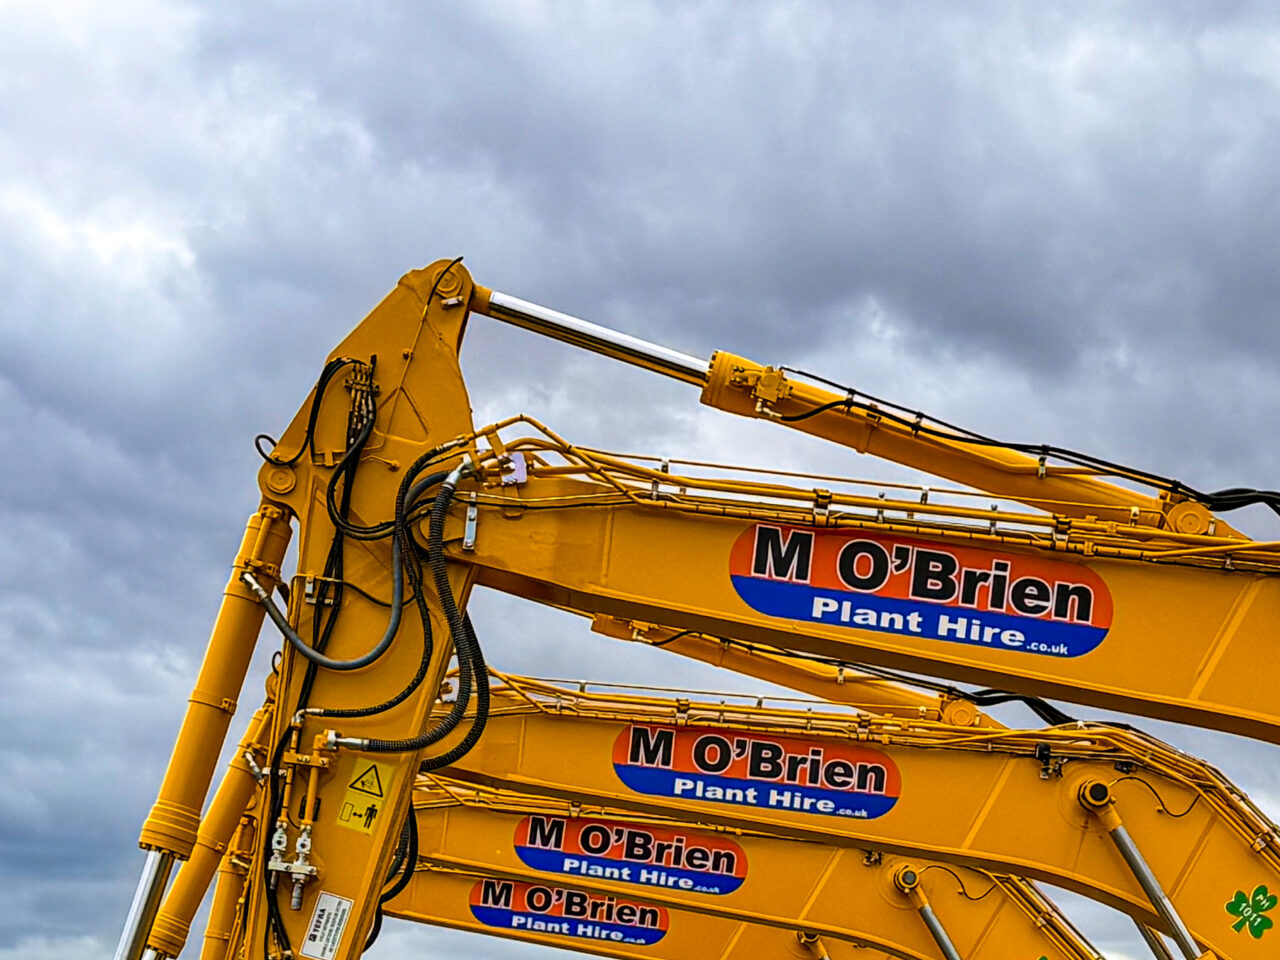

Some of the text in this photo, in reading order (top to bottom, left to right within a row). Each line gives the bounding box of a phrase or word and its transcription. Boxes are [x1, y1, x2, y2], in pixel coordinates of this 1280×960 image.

[753, 524, 1094, 624] M O'Brien
[812, 597, 923, 633] Plant
[628, 725, 887, 795] M O'Brien
[674, 778, 758, 803] Plant
[527, 815, 736, 876] M O'Brien
[563, 858, 631, 880] Plant
[480, 879, 660, 929] M O'Brien
[1239, 903, 1261, 926] 1011
[511, 915, 570, 933] Plant
